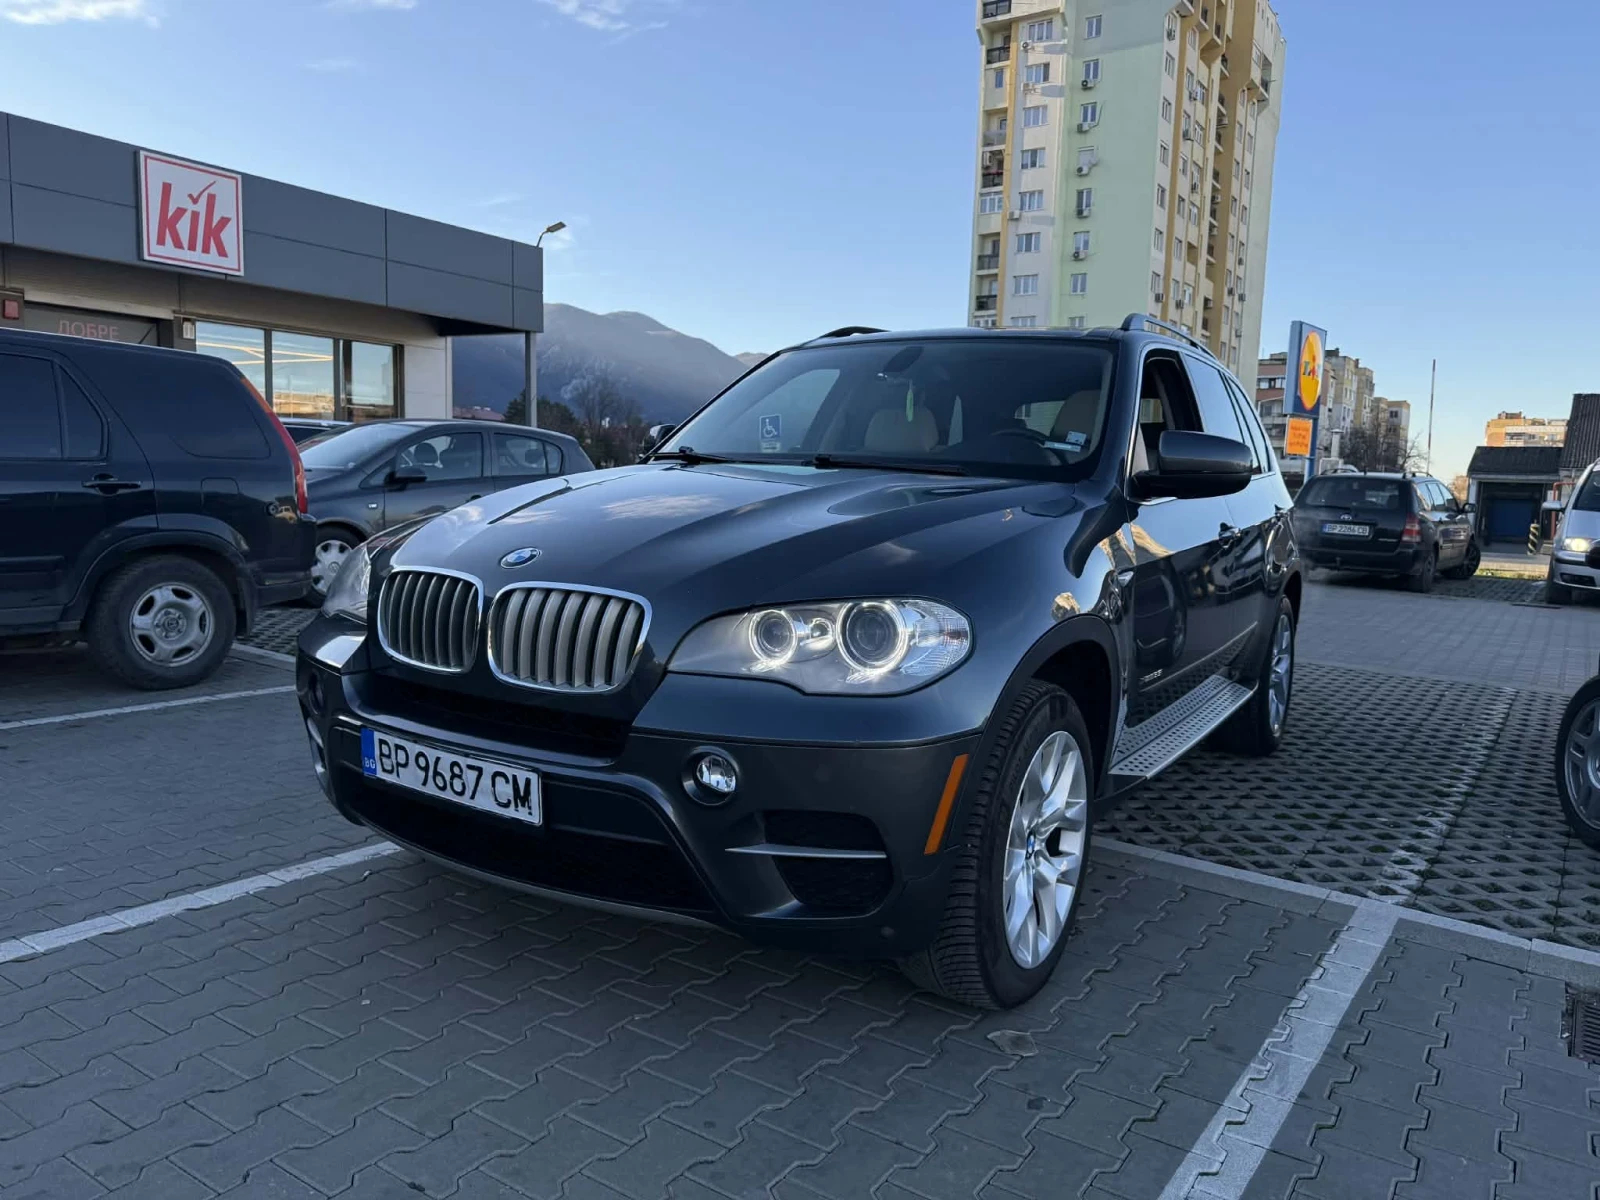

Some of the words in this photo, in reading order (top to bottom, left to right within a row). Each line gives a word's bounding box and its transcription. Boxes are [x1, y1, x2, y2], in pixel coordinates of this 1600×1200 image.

[157, 181, 232, 258] kik
[364, 757, 376, 769] BG
[378, 738, 409, 778] BP
[415, 751, 484, 800] 9687
[491, 771, 533, 816] CM
